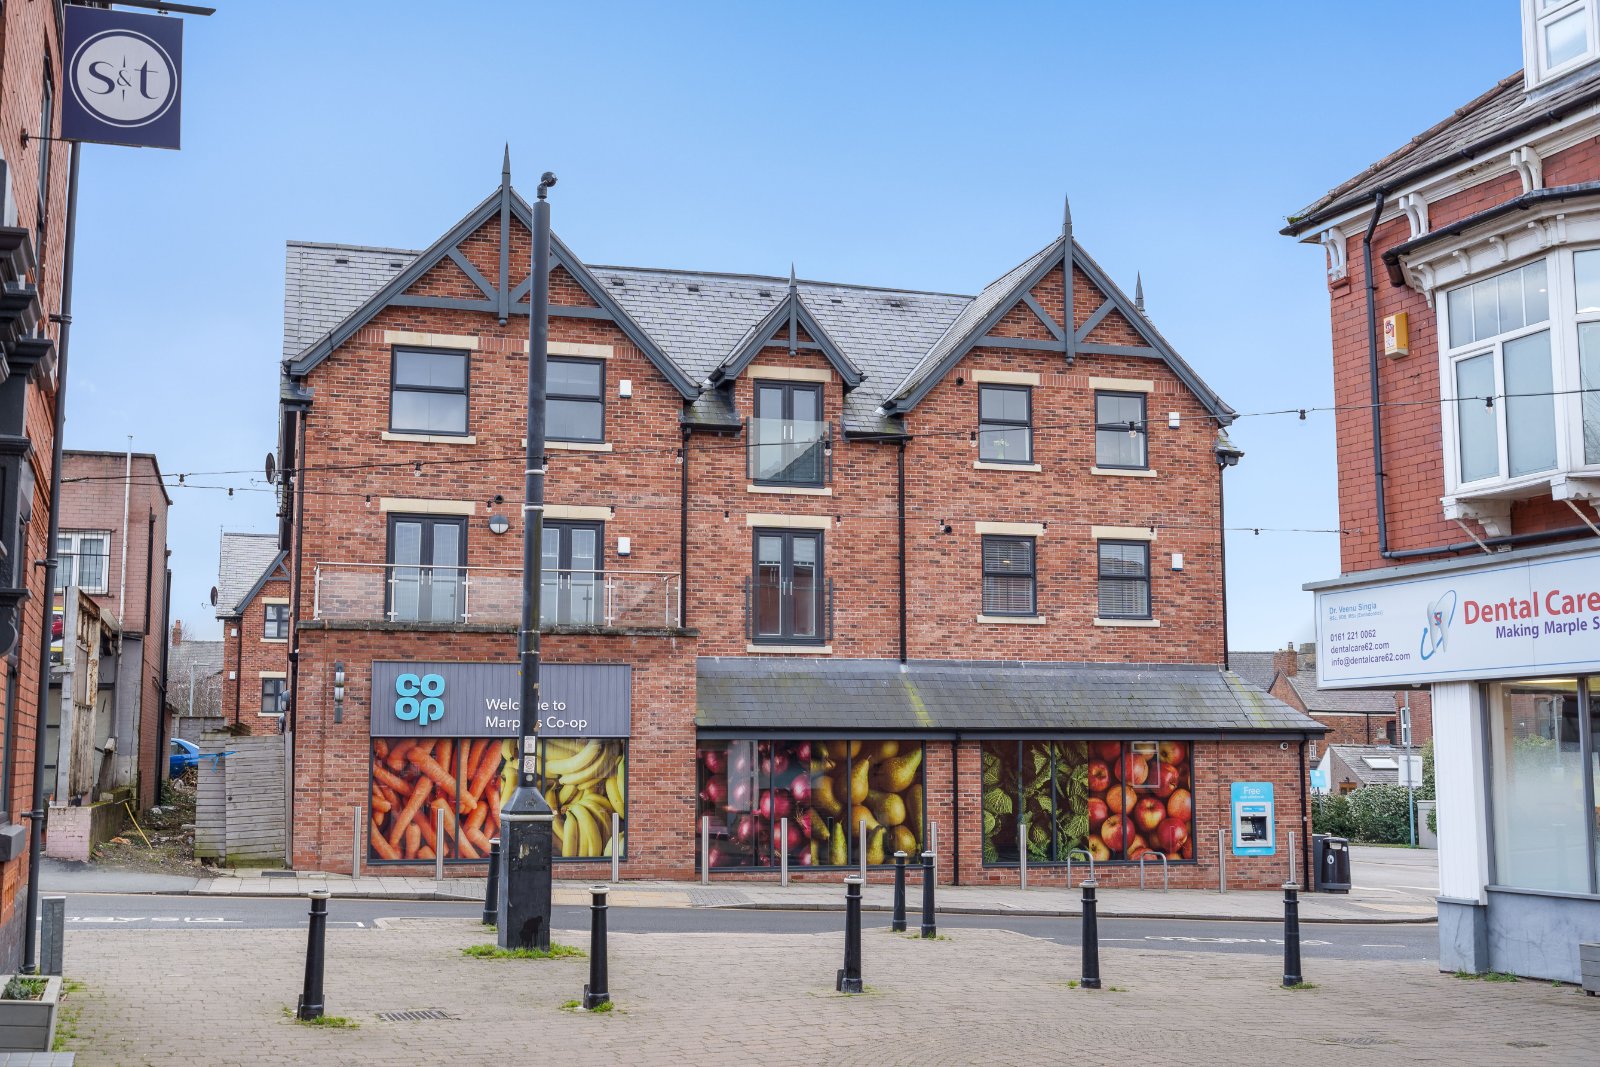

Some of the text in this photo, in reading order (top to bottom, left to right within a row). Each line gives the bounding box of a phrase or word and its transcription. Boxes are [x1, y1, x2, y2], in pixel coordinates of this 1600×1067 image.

[1329, 607, 1338, 615] Dr.
[1463, 590, 1600, 625] Dental Care
[1496, 624, 1539, 639] Making
[1544, 617, 1588, 636] Marple
[1330, 632, 1345, 642] 0161
[1347, 631, 1358, 641] 221
[1330, 642, 1390, 654] dentalcare62.com
[1331, 652, 1411, 667] info@dentalcare62.com
[485, 697, 567, 711] Welce to
[546, 716, 588, 731] Co-op
[1243, 786, 1261, 795] Free
